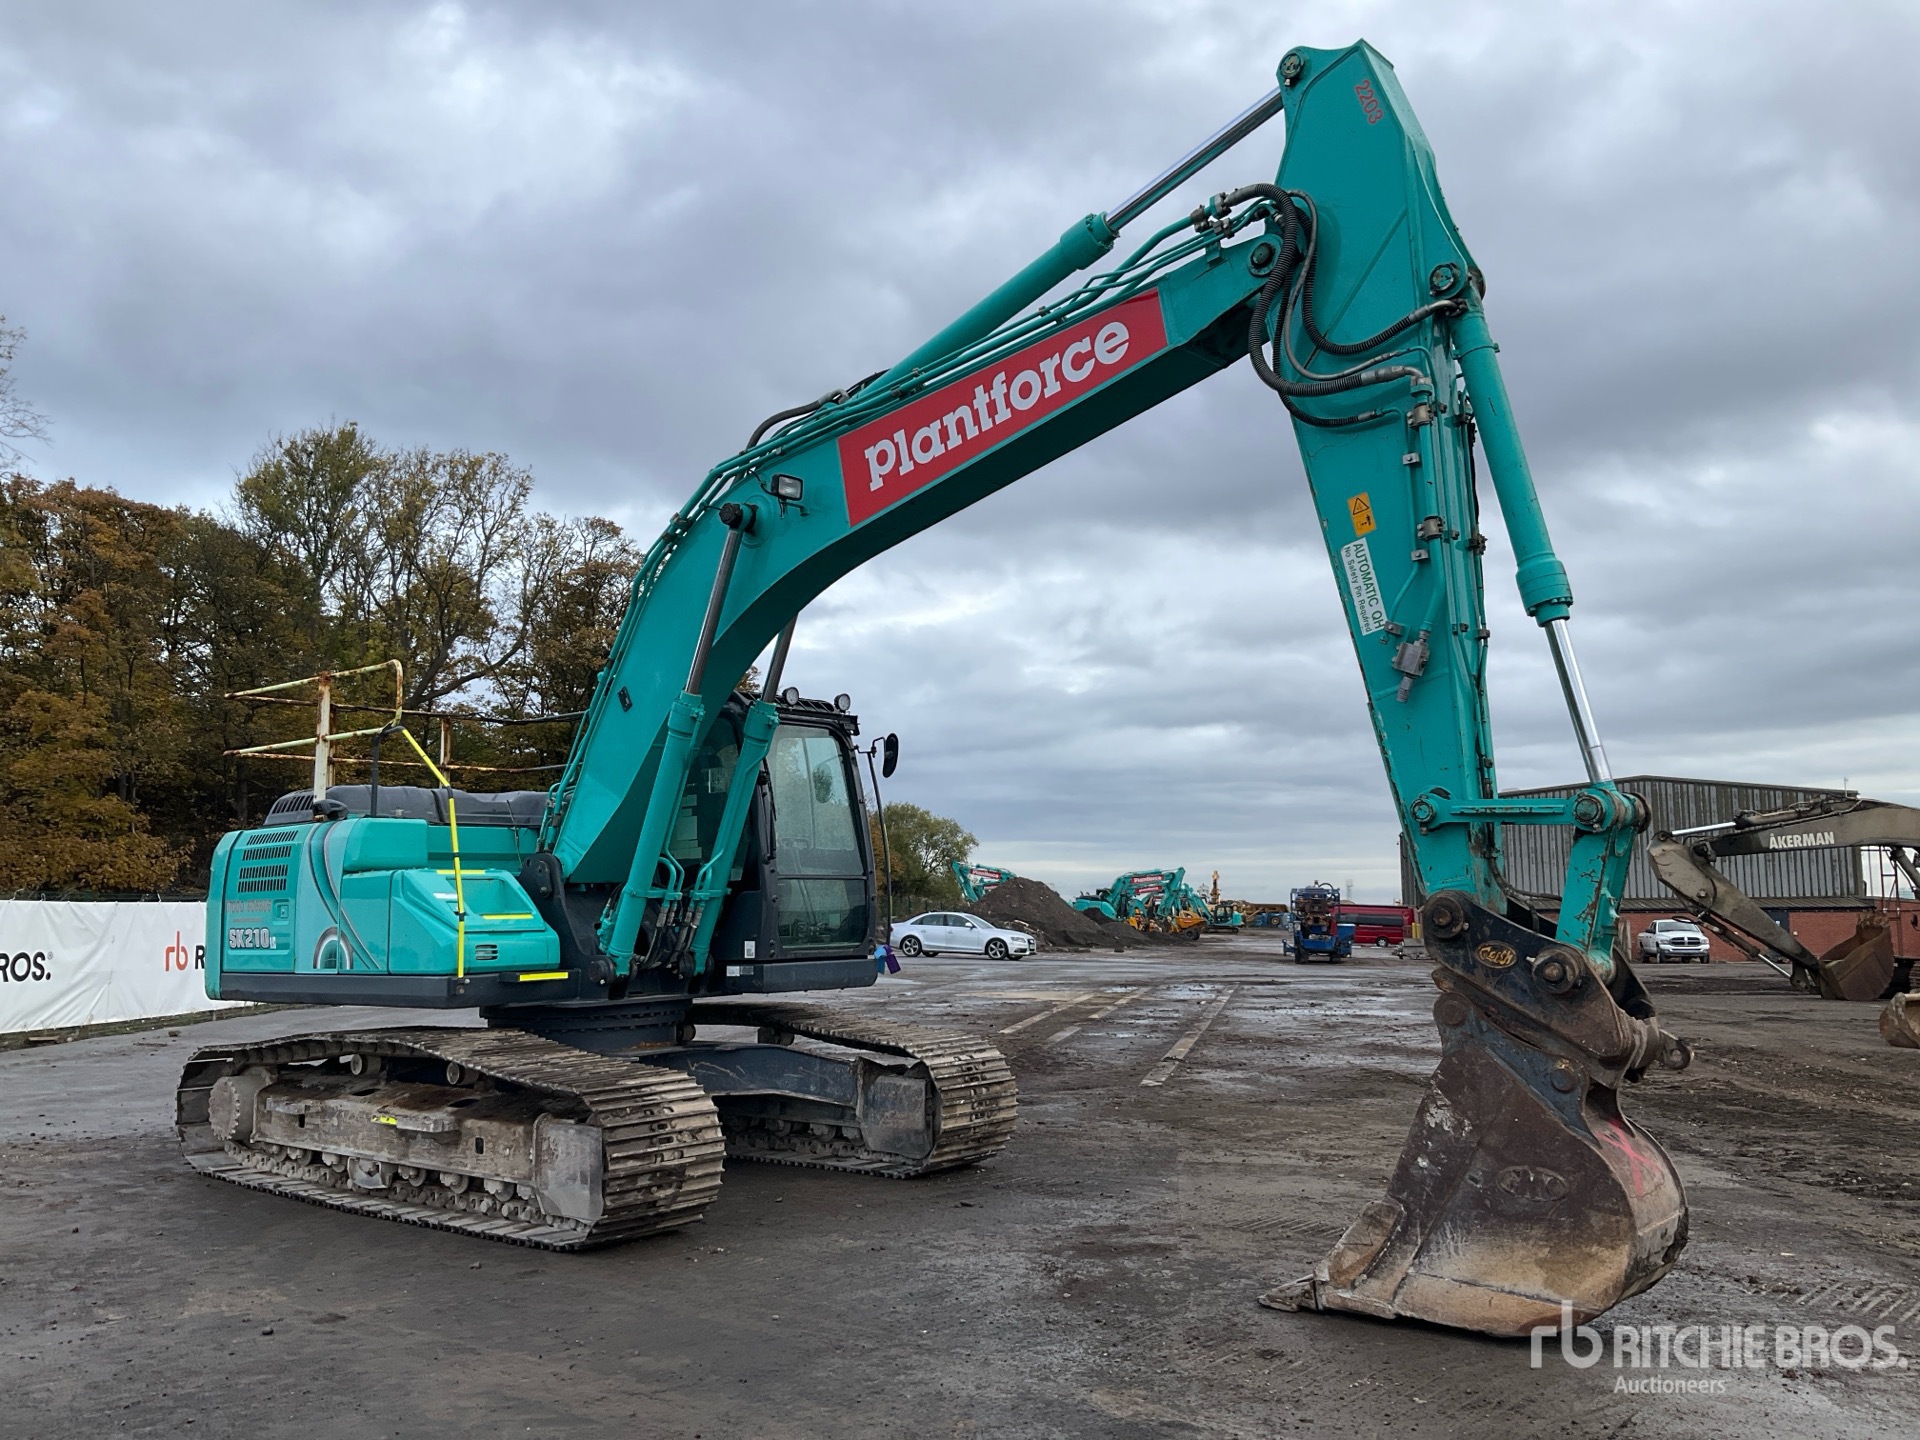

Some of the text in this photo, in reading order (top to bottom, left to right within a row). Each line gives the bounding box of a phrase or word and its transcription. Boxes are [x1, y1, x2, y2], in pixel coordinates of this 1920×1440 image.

[1354, 79, 1383, 124] 2203
[864, 321, 1130, 492] plantforce
[1343, 546, 1372, 632] No Safety Pin Required
[1353, 543, 1384, 629] AUTOMATIC QH
